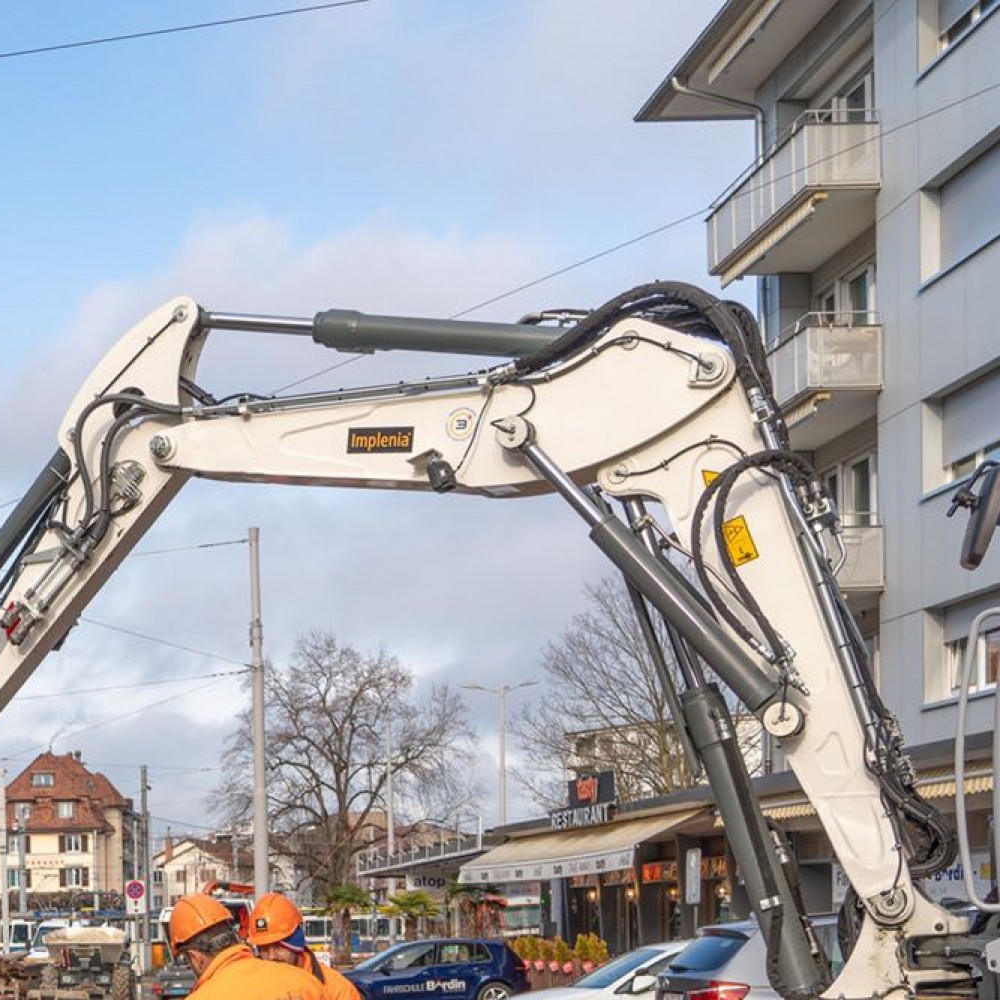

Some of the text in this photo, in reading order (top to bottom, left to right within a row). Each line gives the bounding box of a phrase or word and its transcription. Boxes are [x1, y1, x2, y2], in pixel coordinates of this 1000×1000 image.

[350, 431, 411, 452] Implenia
[551, 803, 609, 832] RESTAURANT
[413, 875, 446, 889] atop
